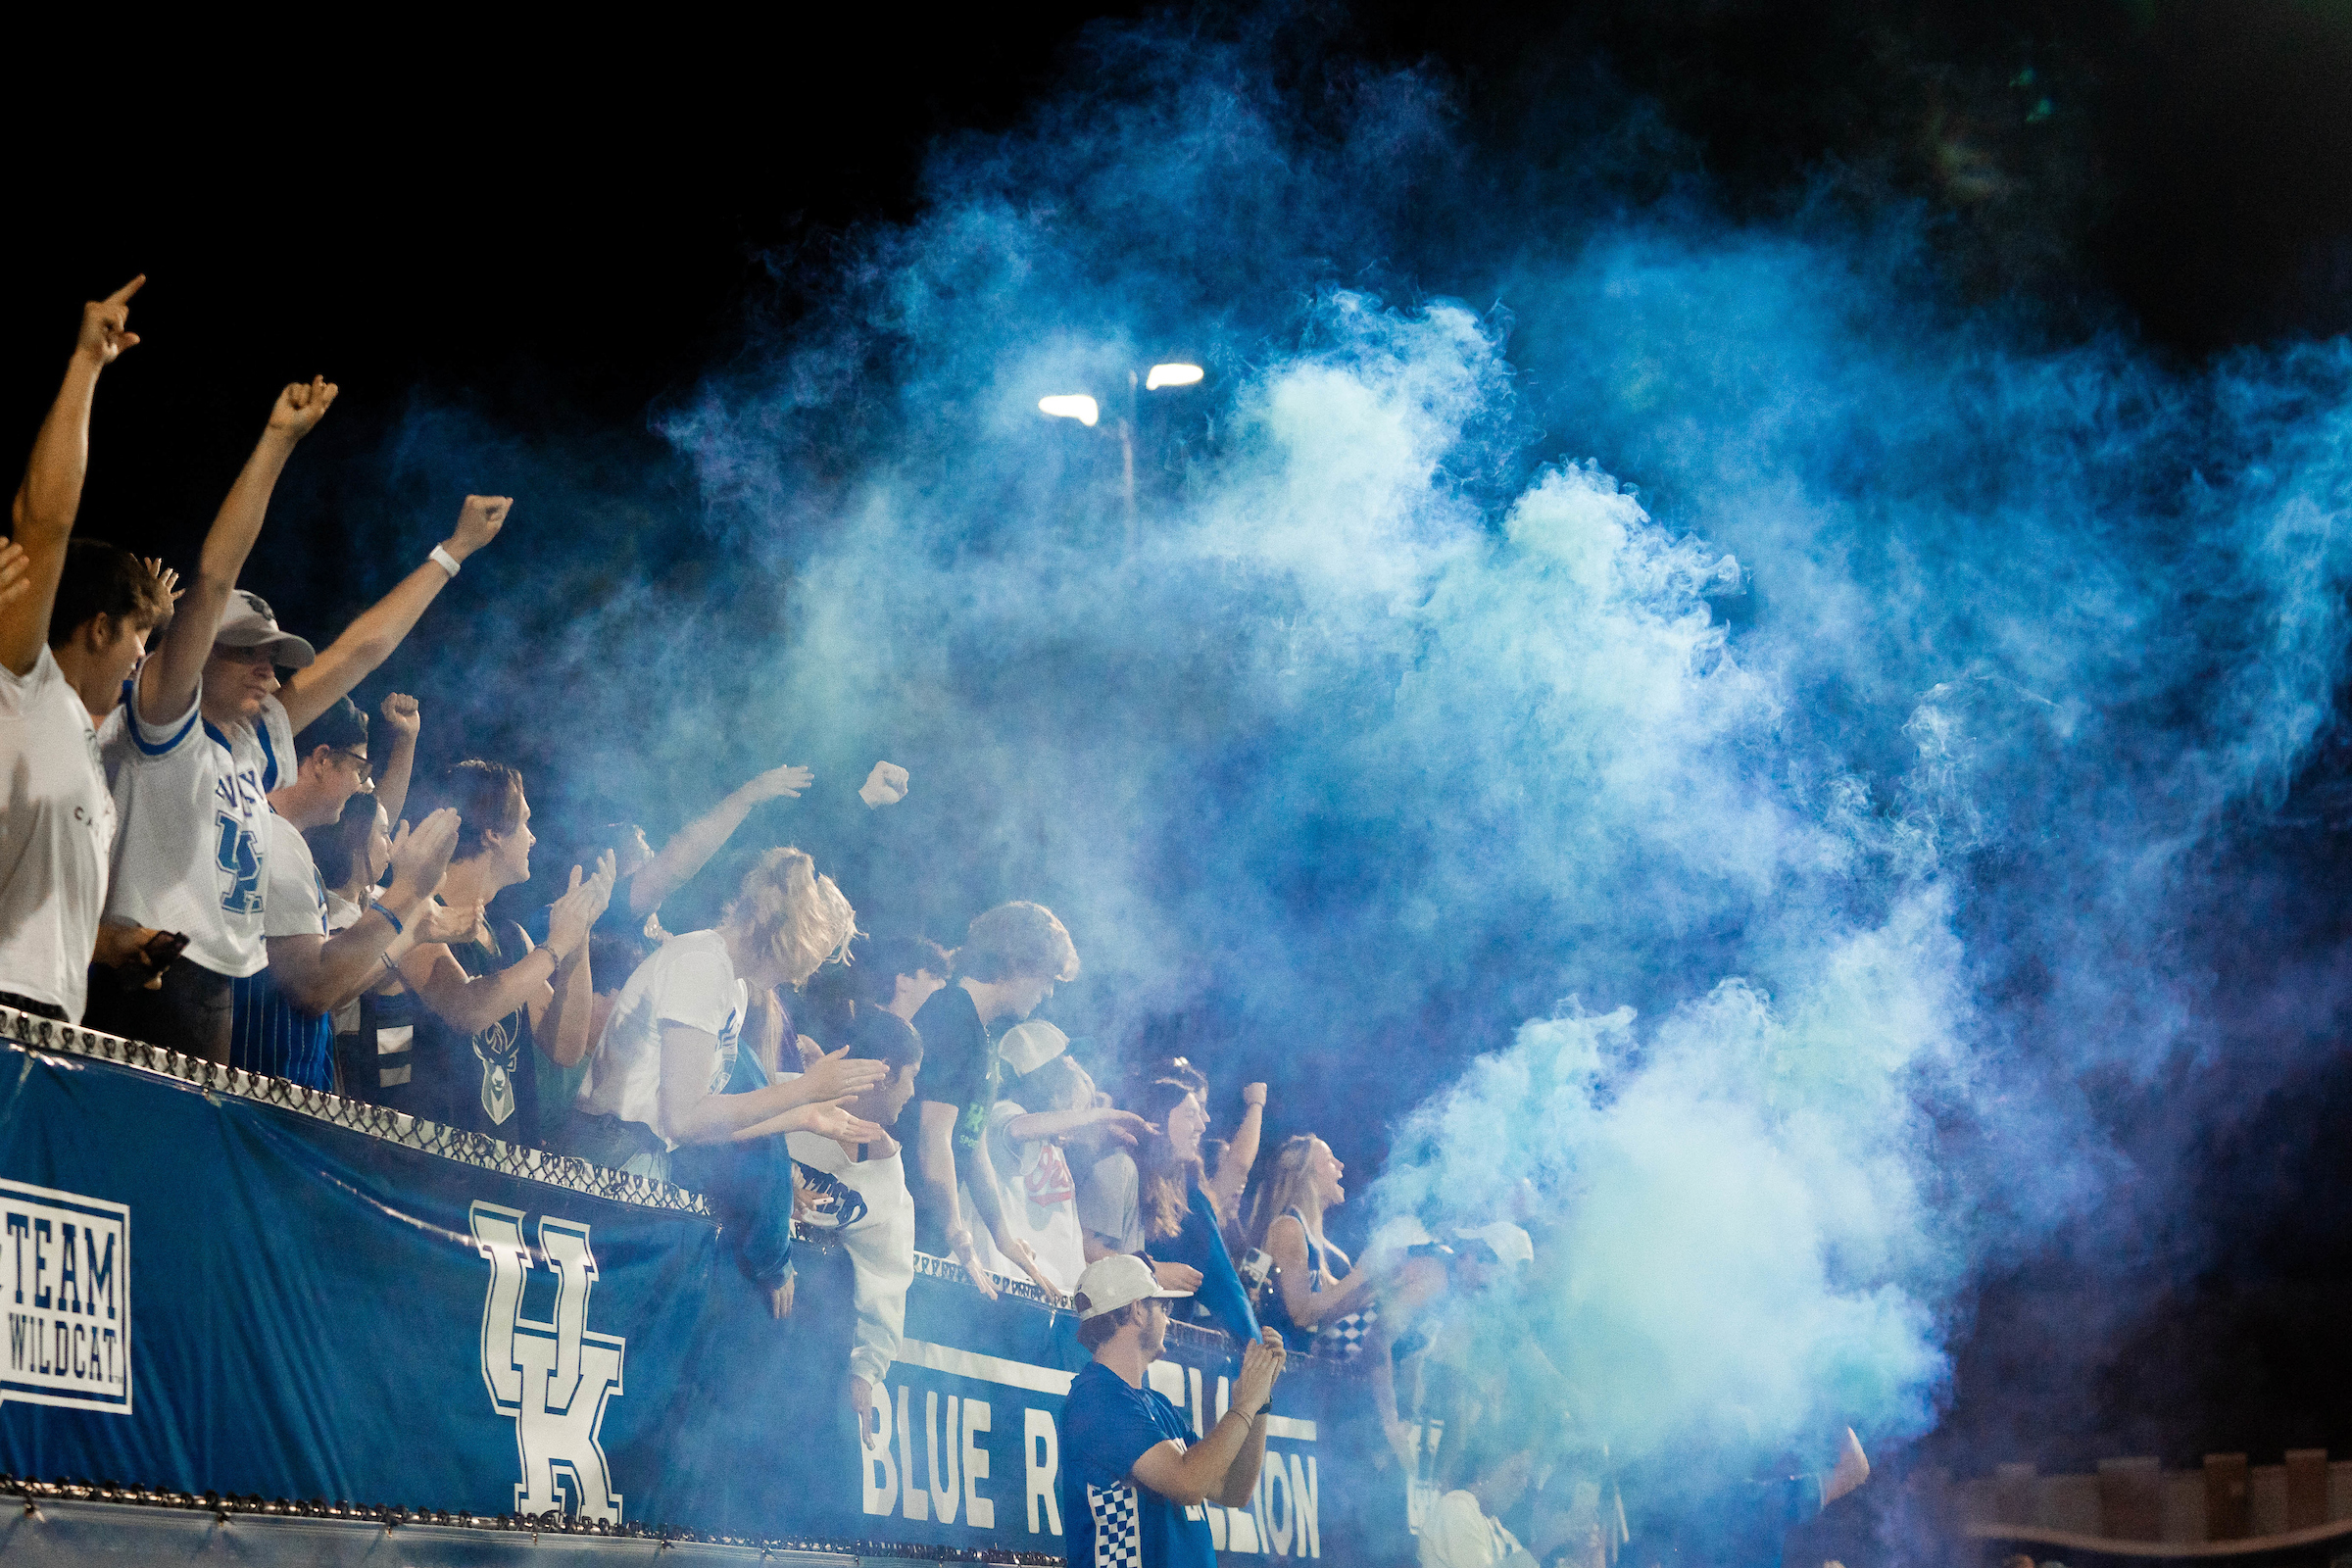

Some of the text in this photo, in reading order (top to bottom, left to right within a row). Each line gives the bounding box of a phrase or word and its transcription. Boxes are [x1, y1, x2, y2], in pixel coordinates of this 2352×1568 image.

[6, 1211, 117, 1321] TEAM
[9, 1312, 118, 1384] WILDCAT
[469, 1199, 626, 1529] UK
[858, 1381, 995, 1530] BLUE
